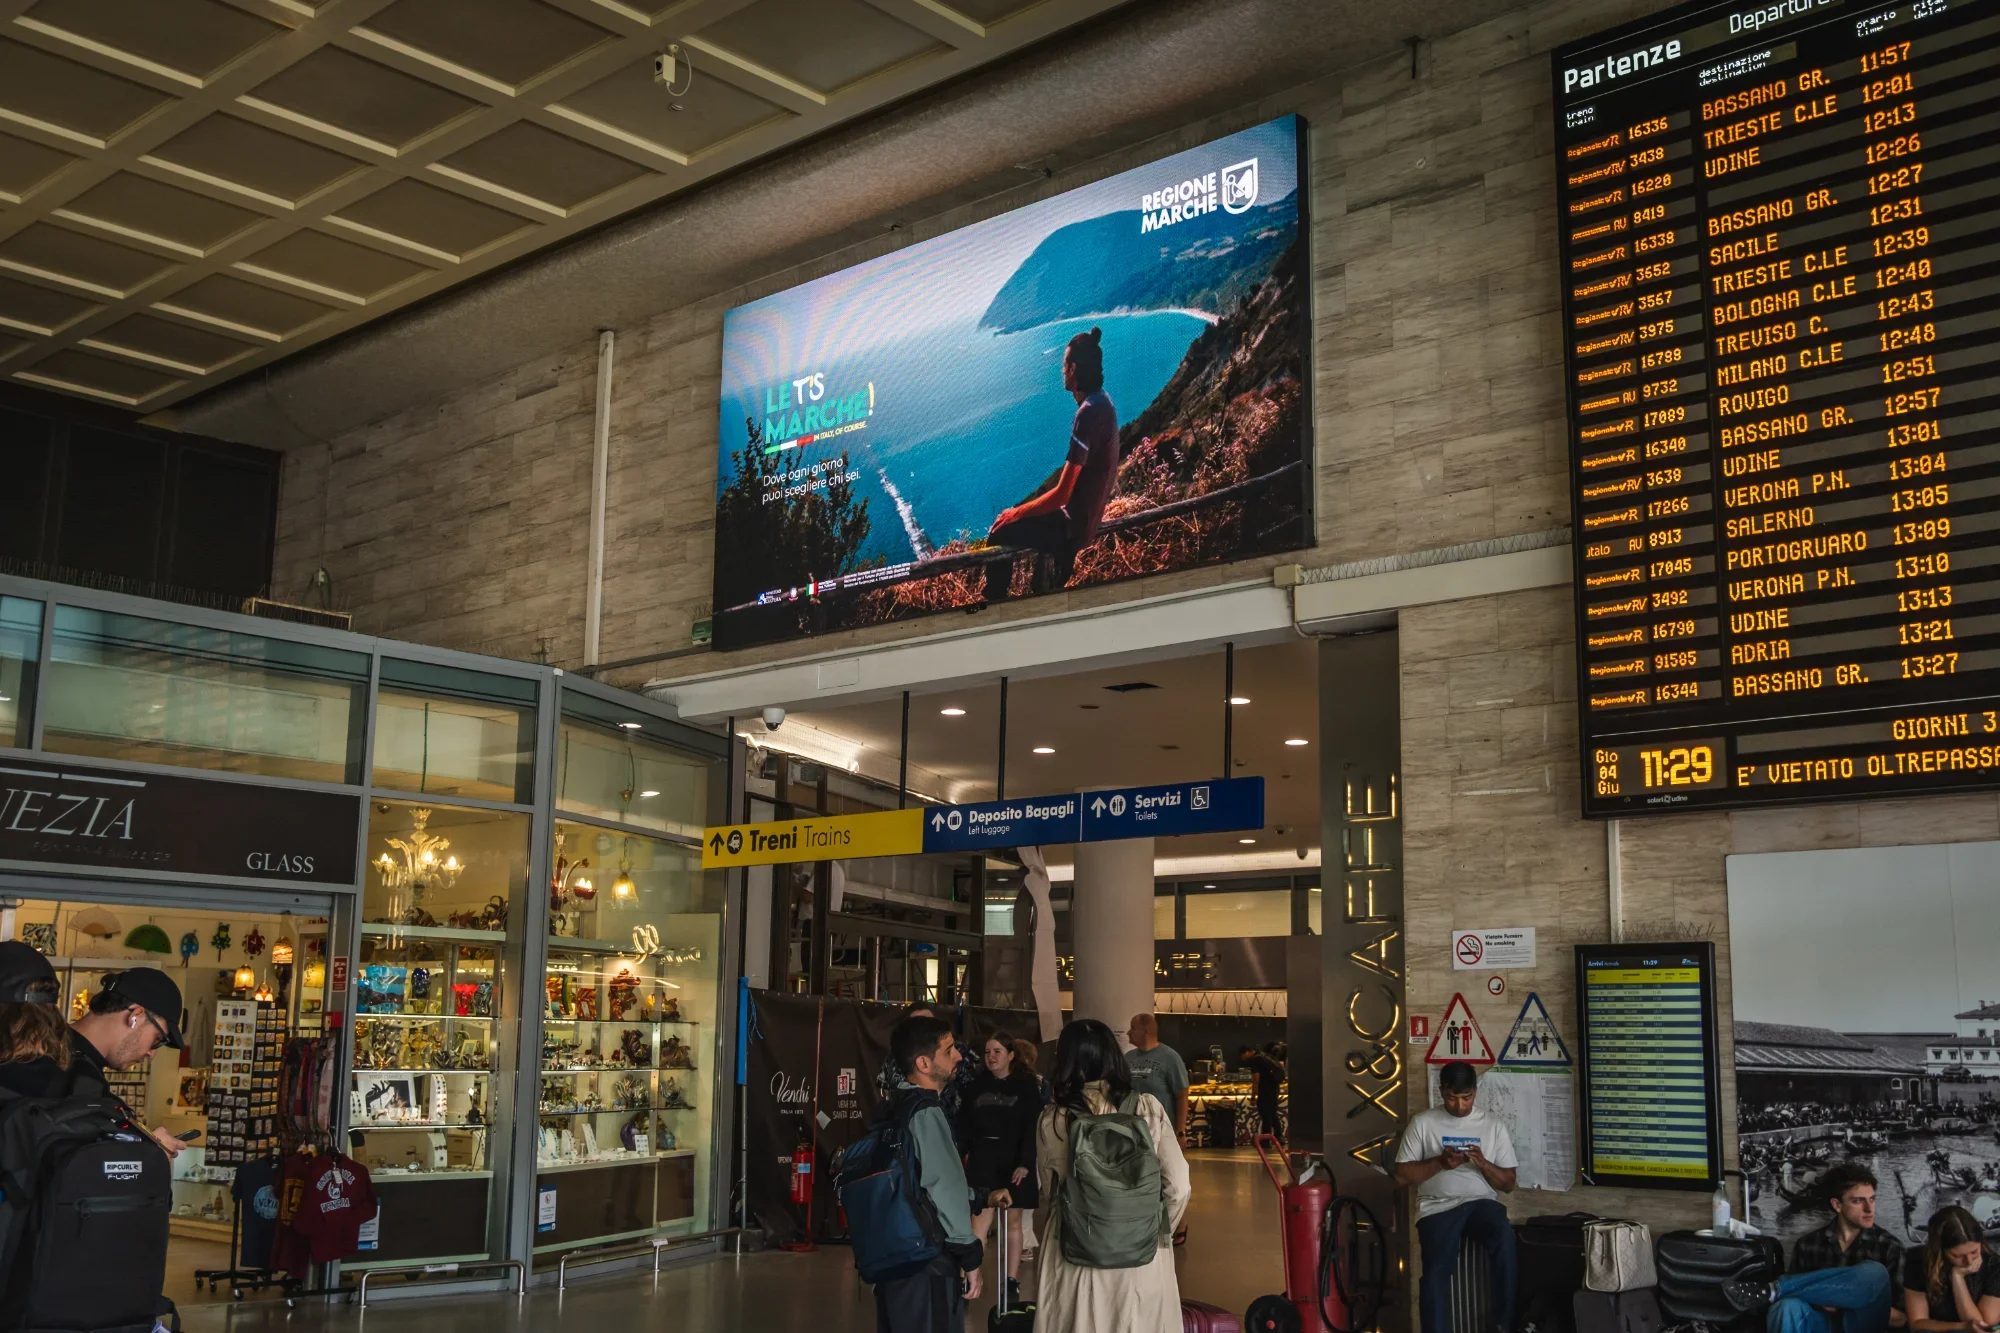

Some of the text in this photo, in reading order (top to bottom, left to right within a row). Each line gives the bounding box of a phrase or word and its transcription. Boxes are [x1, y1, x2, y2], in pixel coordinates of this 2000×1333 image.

[1730, 0, 1834, 34] Departur
[1856, 11, 1896, 29] orario
[1564, 38, 1681, 94] Partenze
[1699, 50, 1771, 78] destinazione
[1629, 42, 1910, 139] 16336 BASSANO GR. 11:57
[1566, 107, 1594, 120] treno
[1630, 73, 1913, 168] 3438 TRIESTE C.LE 12:01
[1632, 103, 1915, 195] 16220 UDINE 12:13
[1142, 171, 1217, 214] REGIONE
[1634, 205, 1664, 223] 8419
[1866, 133, 1920, 164] 12:26
[1141, 192, 1218, 234] MARCHE
[1709, 199, 1792, 236] BASSANO
[1806, 189, 1837, 210] GR.
[1869, 164, 1922, 195] 12:27
[1636, 197, 1922, 282] 3652 SACILE 12:31
[1638, 227, 1928, 311] 3567 TRIESTE C.LE 12:39
[1639, 259, 1931, 340] 3975 BOLOGNA C.LE 12:40
[1716, 322, 1796, 355] TREVISO
[1810, 316, 1828, 334] C.
[1878, 290, 1933, 320] 12:43
[1643, 379, 1677, 398] 9732
[1718, 355, 1786, 386] MILANO
[1800, 342, 1843, 368] C.LE
[1880, 323, 1935, 351] 12:48
[766, 372, 825, 414] LET'S
[1645, 407, 1684, 427] 17089
[1720, 385, 1788, 416] ROVIGO
[1883, 355, 1935, 383] 12:51
[765, 382, 875, 444] MARCHE!
[820, 430, 835, 440] ITALY,
[835, 426, 844, 435] OF
[1646, 437, 1686, 457] 16340
[1722, 414, 1808, 447] BASSANO
[1822, 406, 1853, 428] GR.
[1885, 387, 1940, 416] 12:57
[763, 457, 844, 487] Dove ogni giorno
[1647, 467, 1682, 487] 3638
[1724, 449, 1780, 476] UDINE
[1888, 420, 1940, 447] 13:01
[762, 467, 861, 505] puoi scegliere chi sei.
[1648, 497, 1689, 516] 17266
[1725, 478, 1799, 507] VERONA
[1813, 470, 1850, 493] P.N.
[1890, 452, 1946, 480] 13:04
[1629, 538, 1642, 551] AV
[1650, 529, 1681, 547] 8913
[1727, 507, 1813, 538] SALERNO
[1892, 484, 1948, 512] 13:05
[1651, 558, 1692, 577] 17045
[1728, 531, 1867, 570] PORTOGRUARO
[1894, 518, 1950, 545] 13:09
[1652, 590, 1688, 609] 3492
[1729, 574, 1804, 601] VERONA
[1818, 567, 1855, 589] P.N.
[1896, 553, 1949, 578] 13:10
[1653, 620, 1694, 638] 16790
[1731, 608, 1789, 633] UDINE
[1898, 586, 1952, 612] 13:13
[1655, 651, 1696, 669] 91585
[1732, 640, 1790, 664] ADRIA
[1899, 619, 1953, 644] 13:21
[1656, 682, 1698, 700] 16344
[1733, 668, 1822, 696] BASSANO
[1836, 664, 1869, 685] GR.
[1902, 653, 1958, 678] 13:27
[1893, 711, 1997, 740] GIORNI 3
[1596, 749, 1618, 764] Gio
[1599, 764, 1617, 779] 04
[1640, 746, 1712, 787] 11:29
[1738, 766, 1755, 786] E'
[1768, 758, 1853, 783] VIETATO
[1134, 790, 1181, 809] Servizi
[1597, 780, 1620, 795] Giu
[968, 824, 1010, 836] Left Luggage
[969, 801, 1074, 826] Deposito Bagagli
[1135, 810, 1158, 821] Toilets
[749, 825, 851, 852] Treni Trains
[246, 852, 315, 875] GLASS
[770, 1070, 810, 1104] Venchi
